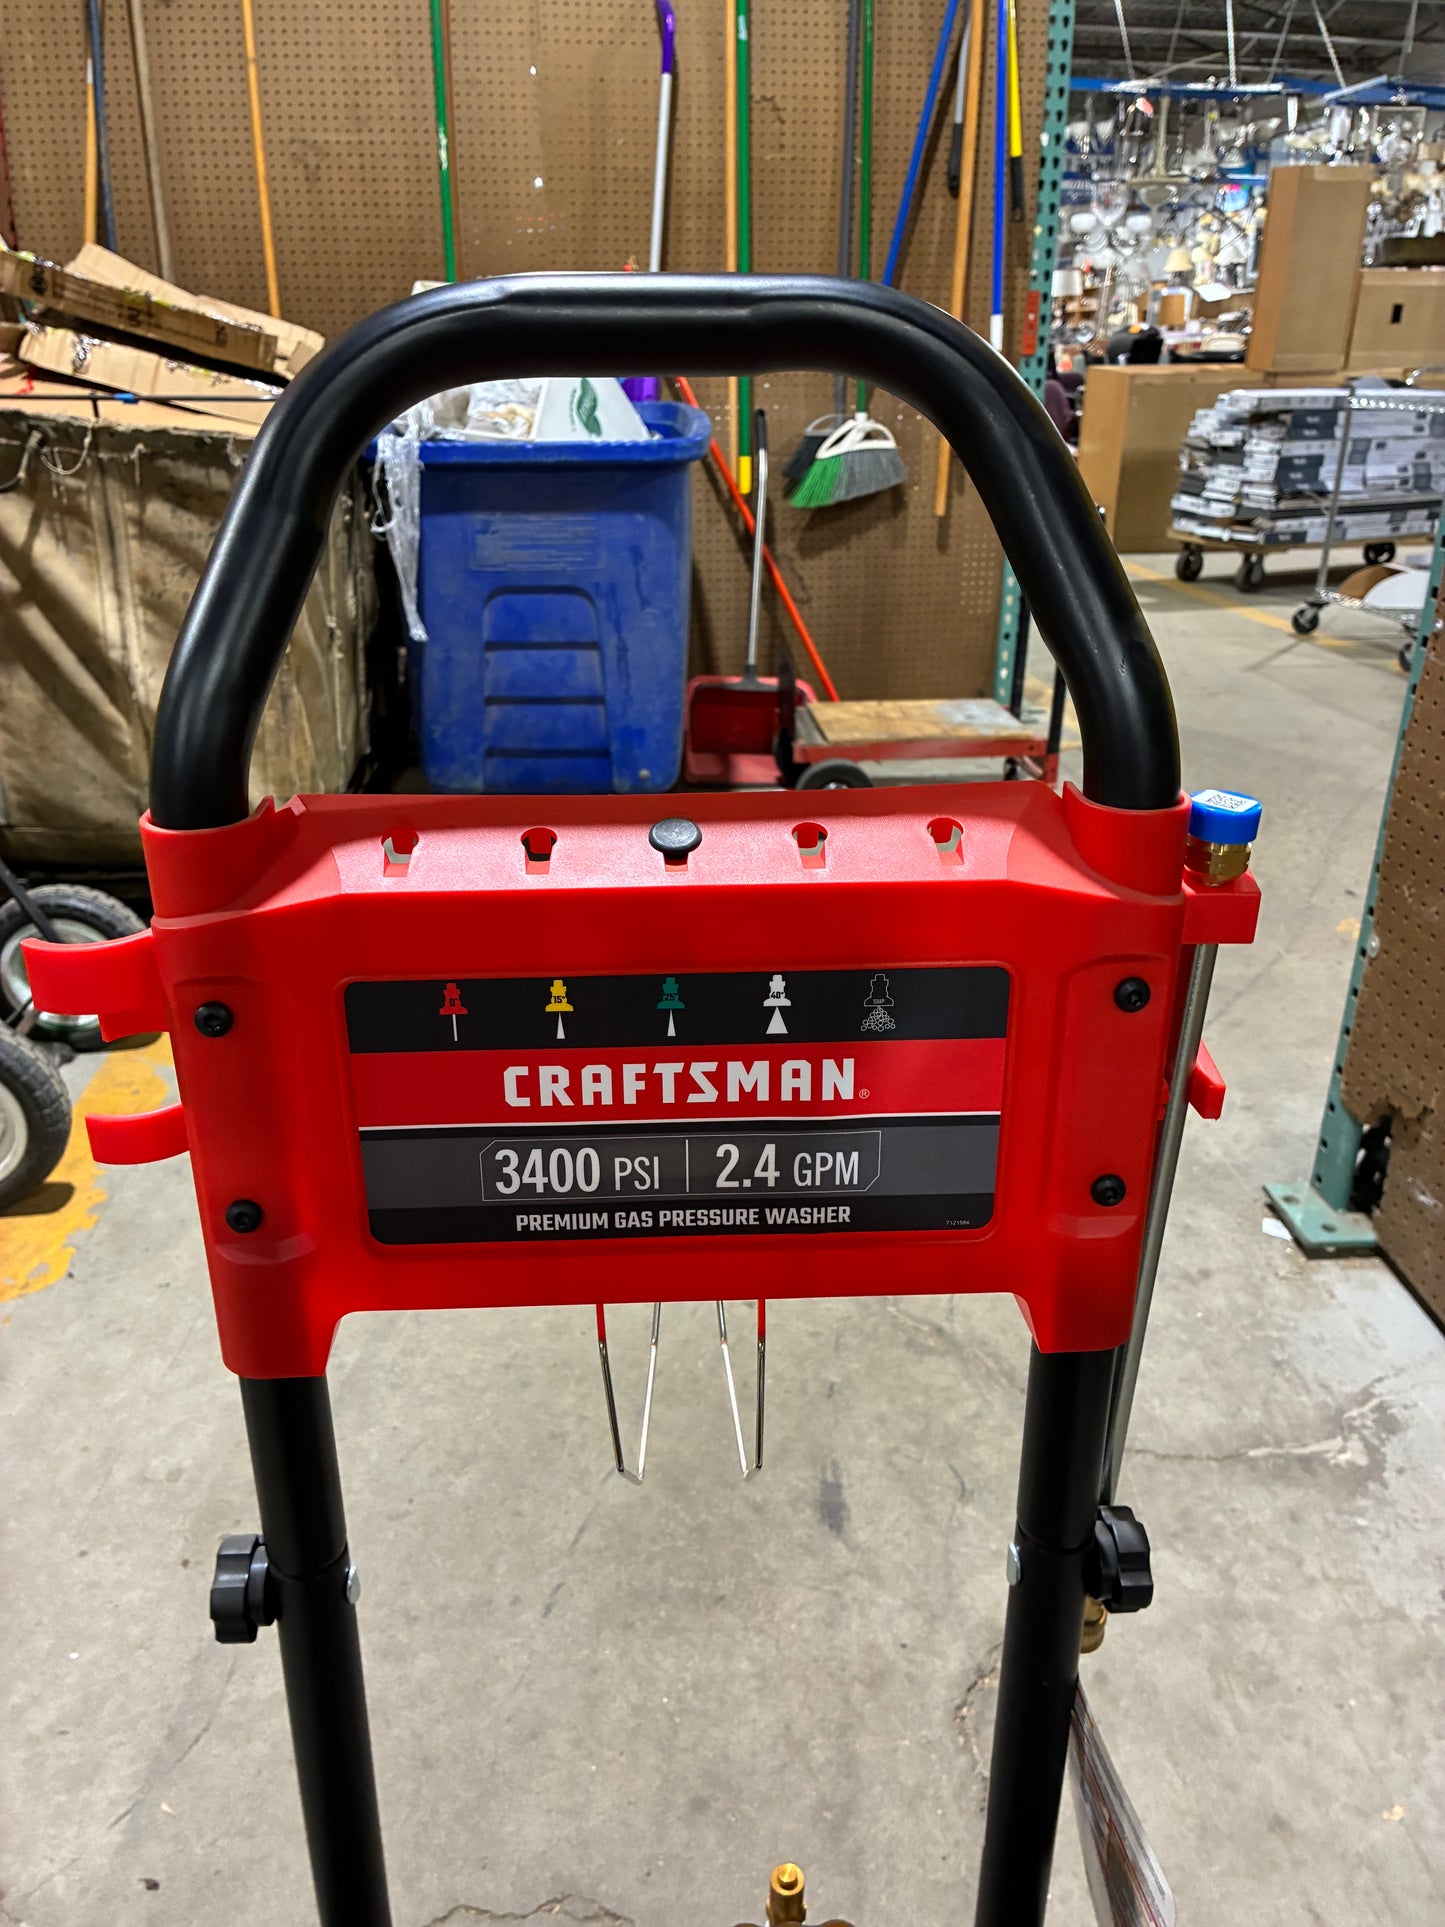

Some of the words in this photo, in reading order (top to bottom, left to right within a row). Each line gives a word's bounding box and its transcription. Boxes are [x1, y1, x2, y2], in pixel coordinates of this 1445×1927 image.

[495, 1148, 600, 1194] 3400
[614, 1156, 660, 1191] PSI
[715, 1143, 780, 1188] 2.4
[793, 1151, 859, 1187] GPM
[516, 1212, 609, 1231] PREMIUM
[614, 1210, 653, 1229] GAS
[658, 1208, 760, 1228] PRESSURE
[765, 1205, 851, 1225] WASHER
